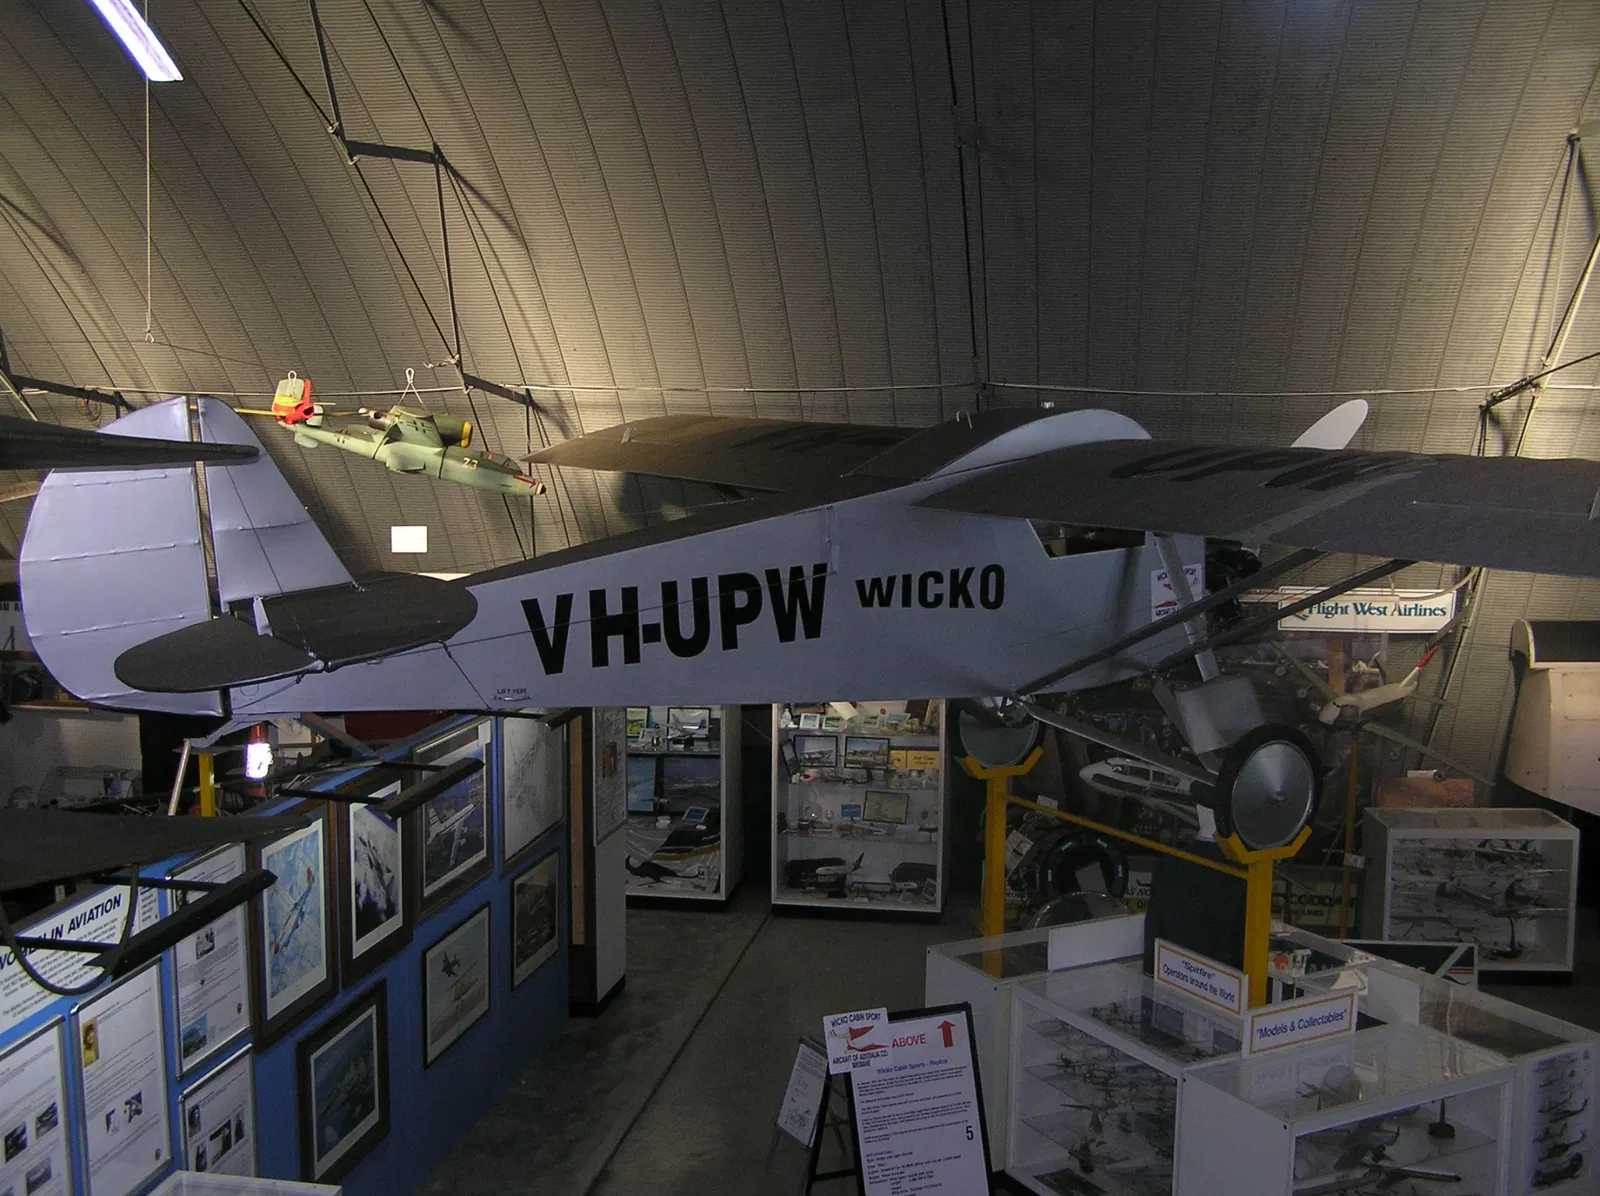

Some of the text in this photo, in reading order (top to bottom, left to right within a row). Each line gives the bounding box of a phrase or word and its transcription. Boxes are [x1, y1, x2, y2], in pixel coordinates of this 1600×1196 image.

[462, 457, 479, 470] 23
[855, 564, 1006, 610] WICKO
[521, 562, 828, 675] VH-UPW
[1308, 602, 1447, 619] Flight West Airlines
[0, 933, 46, 970] WOM
[51, 924, 65, 941] IN
[68, 893, 122, 934] AVIATION
[1163, 963, 1235, 1003] Operators around the World
[1289, 1020, 1295, 1032] &
[892, 1034, 926, 1048] ABOVE
[965, 1125, 974, 1141] 5
